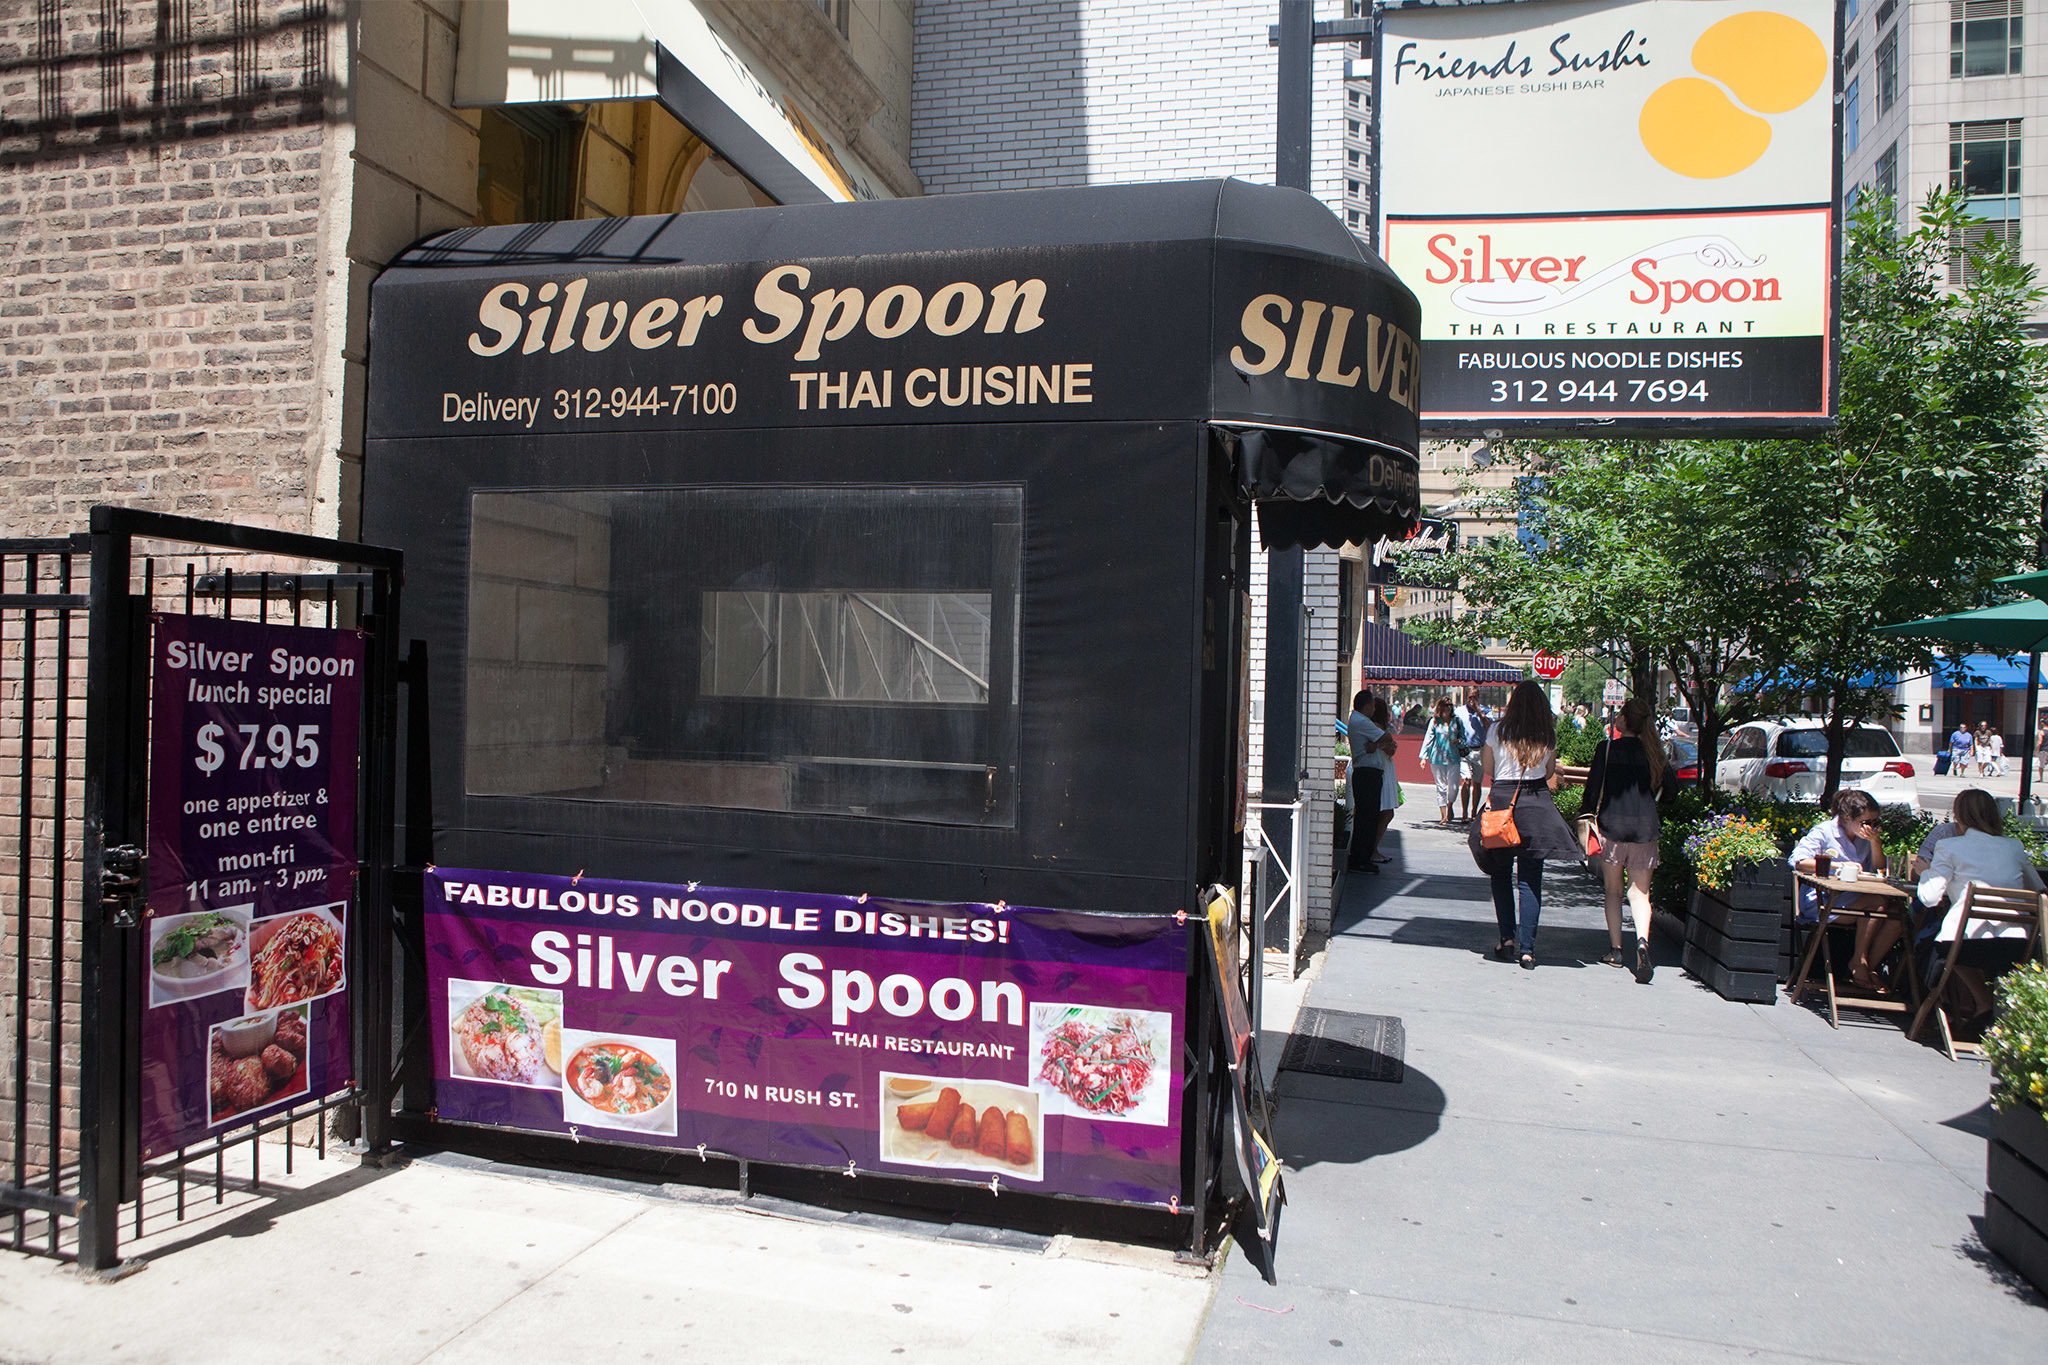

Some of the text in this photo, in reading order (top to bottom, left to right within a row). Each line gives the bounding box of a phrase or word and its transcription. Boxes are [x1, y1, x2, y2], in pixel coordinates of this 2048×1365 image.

[1395, 30, 1650, 84] Friends Sushi
[1435, 80, 1604, 98] JAPANESE SUSHI BAR
[1426, 234, 1781, 314] Silver Spoon
[469, 265, 1046, 361] Silver Spoon
[1450, 321, 1754, 335] THAI RESTAURANT
[1230, 293, 1420, 420] SILVER
[1459, 352, 1742, 368] FABULOUS NOODLE DISHES
[789, 364, 1092, 410] THAI CUISINE
[1491, 380, 1708, 402] 312 944 7694
[444, 383, 736, 428] Delivery 312-944-7100
[1369, 453, 1418, 498] Deliver
[167, 641, 354, 680] Silver Spoon
[1536, 657, 1563, 669] STOP
[189, 678, 331, 709] lunch special
[195, 721, 319, 777] $ 7.95
[184, 788, 328, 818] one appetizer &
[200, 813, 316, 838] one entree
[218, 844, 295, 872] mon-fri
[187, 880, 208, 901] 11
[219, 879, 256, 897] am.
[277, 869, 288, 887] 3
[293, 868, 327, 889] pm.
[444, 882, 1007, 943] FABULOUS NOODLE DISHES!
[529, 930, 1022, 1026] Silver Spoon
[832, 1032, 1014, 1060] THAI RESTAURANT
[705, 1079, 858, 1108] 710 N RUSH ST.
